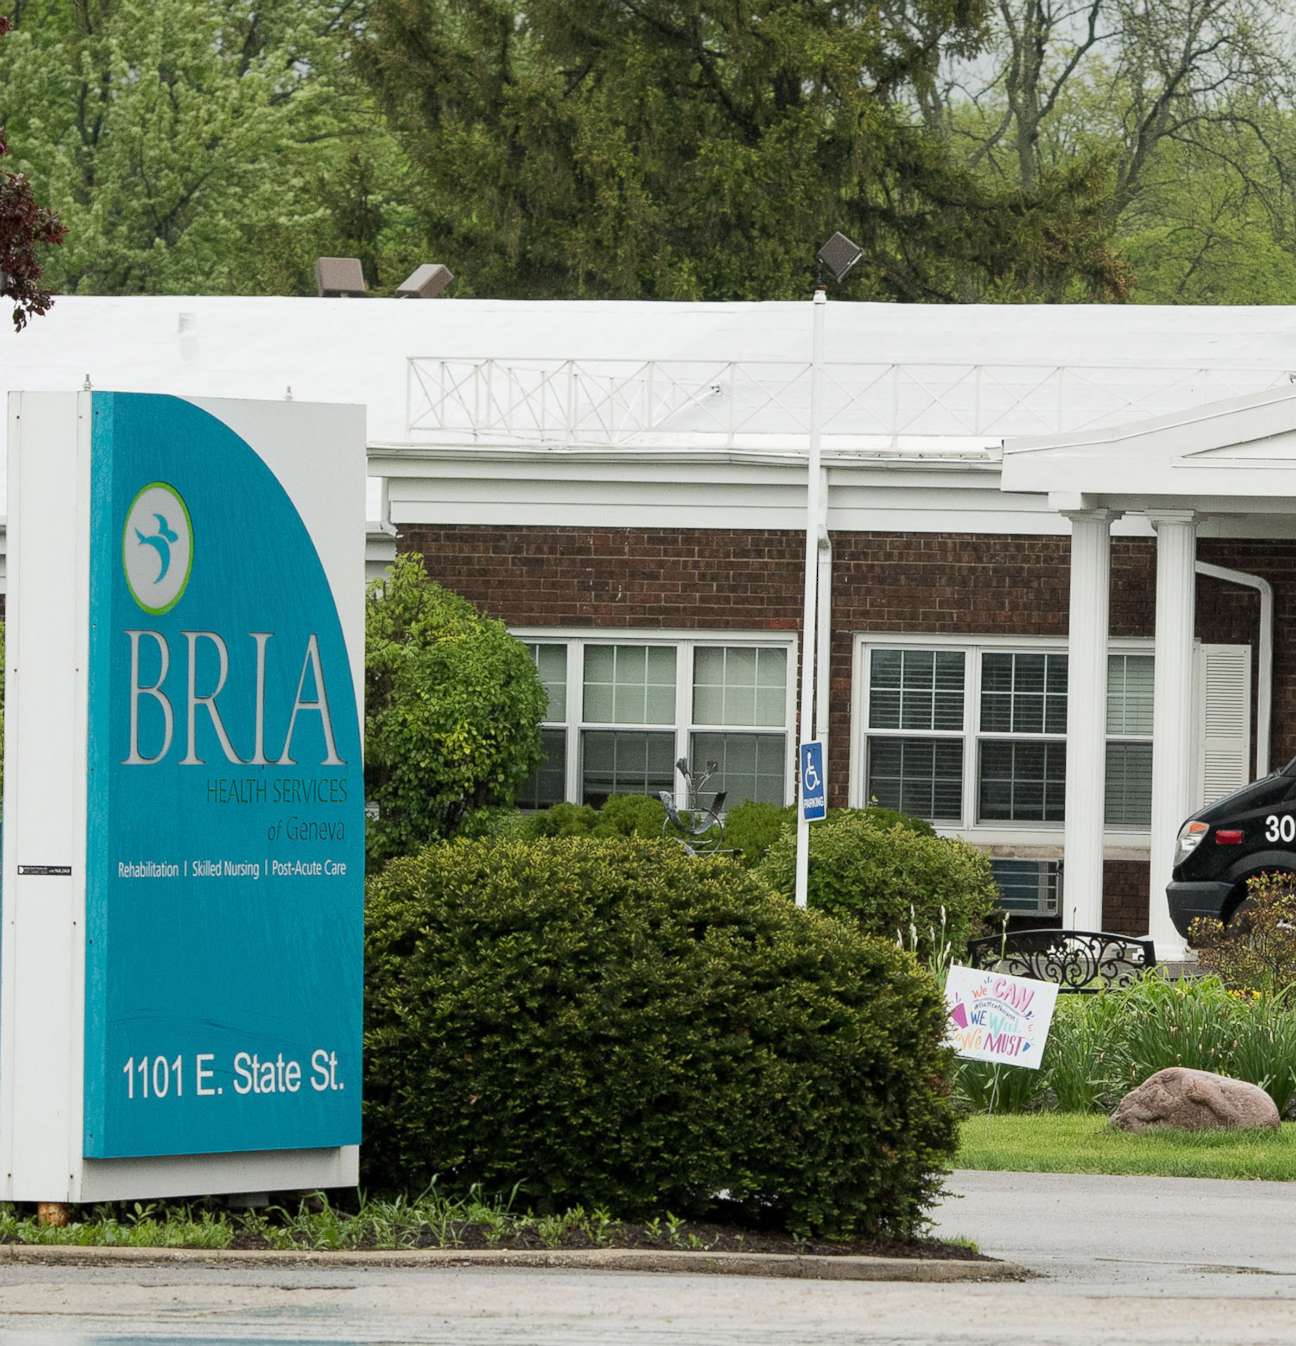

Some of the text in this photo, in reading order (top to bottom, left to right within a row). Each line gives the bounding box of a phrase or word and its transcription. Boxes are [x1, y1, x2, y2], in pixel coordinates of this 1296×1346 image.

[122, 629, 348, 766] BRIA
[207, 778, 348, 804] HEALTH SERVICES
[267, 816, 345, 841] of Geneva
[118, 861, 179, 878] Rehabilitation
[192, 860, 222, 877] Skilled
[223, 861, 260, 880] Nursing
[272, 859, 322, 876] Post-Acute
[324, 859, 347, 875] Care
[992, 978, 1035, 1013] CAN
[970, 1010, 987, 1026] WE
[983, 1032, 1027, 1056] MUST
[123, 1049, 345, 1099] 1101 E. State St.
